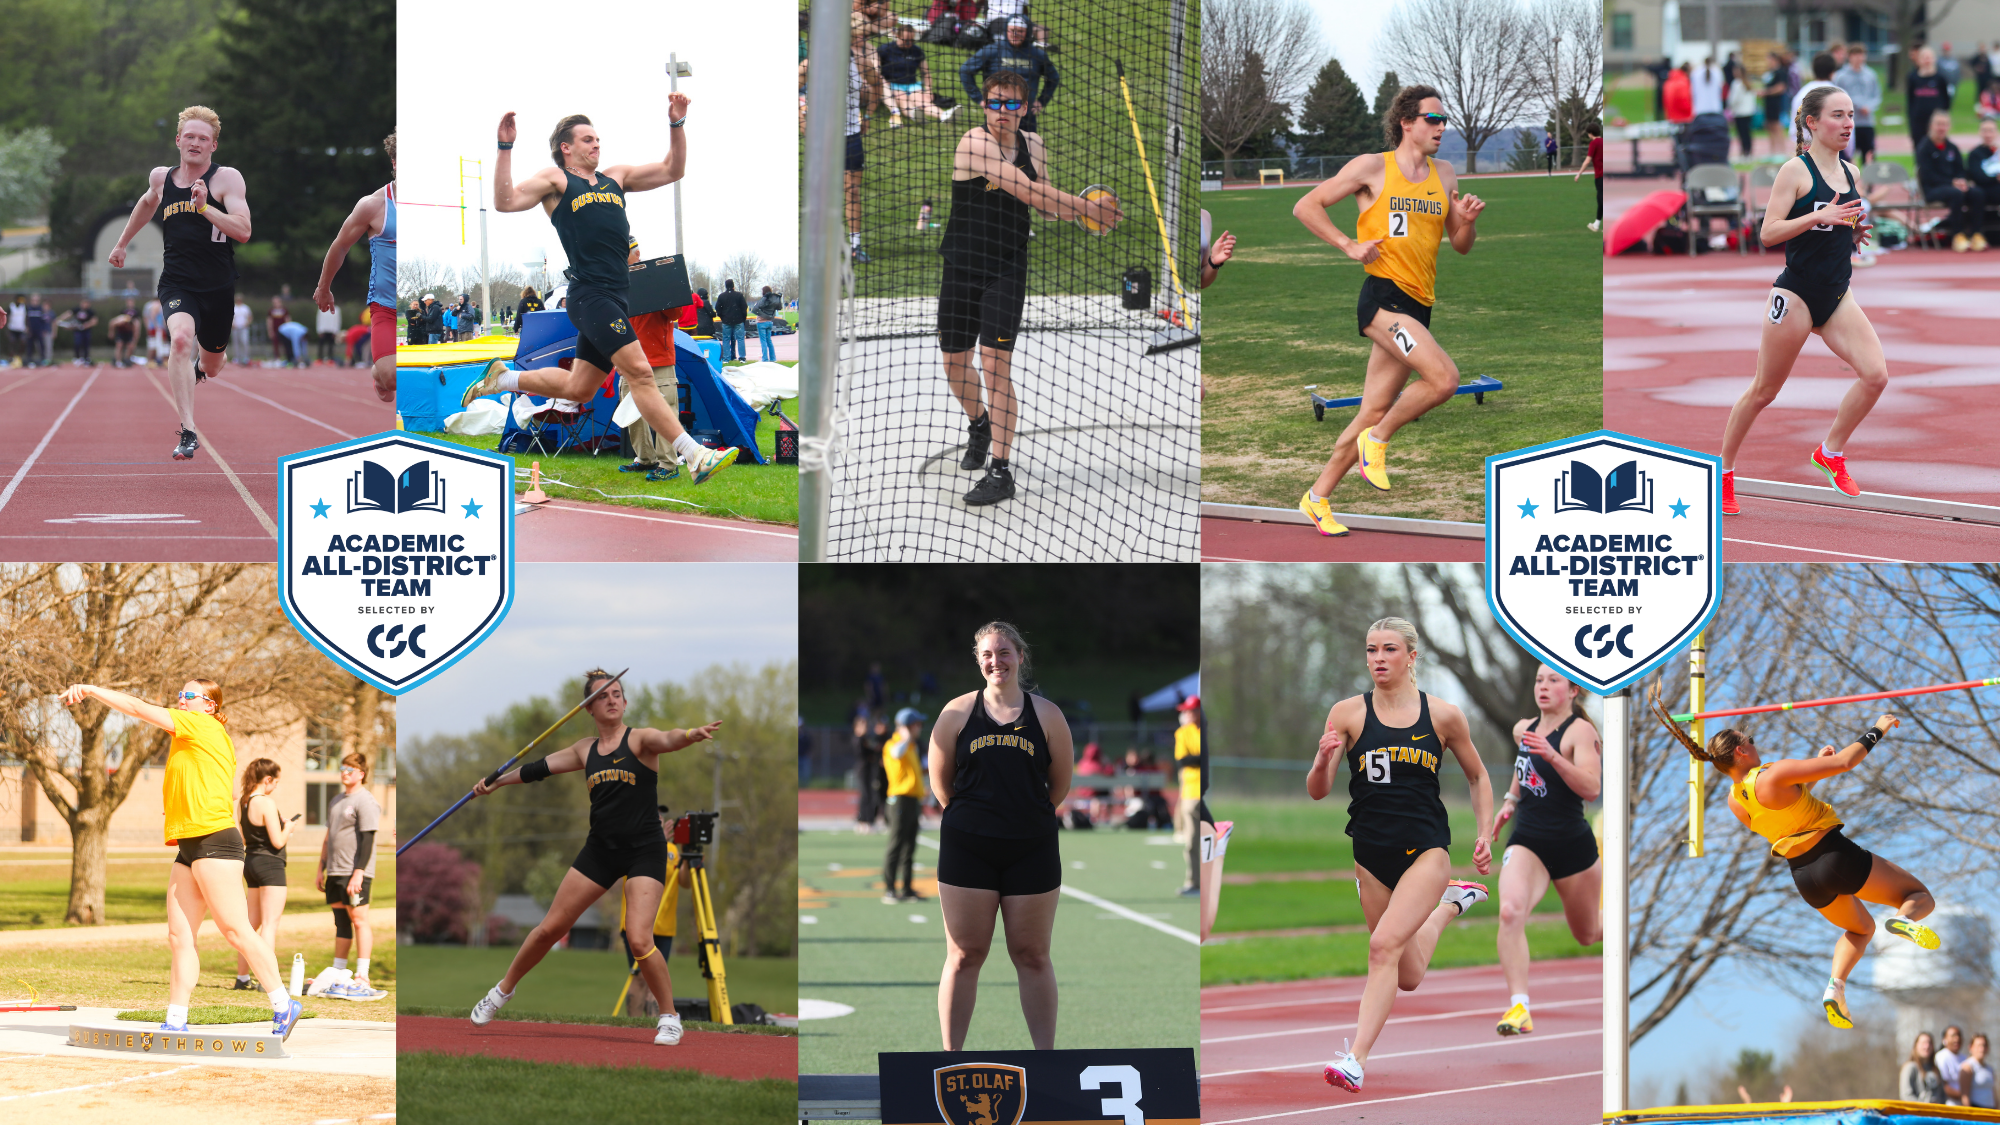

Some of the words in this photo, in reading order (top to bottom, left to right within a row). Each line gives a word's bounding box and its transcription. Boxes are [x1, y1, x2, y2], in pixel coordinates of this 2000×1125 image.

[1390, 196, 1442, 216] GUSTAVUS
[1392, 213, 1405, 237] 2
[1772, 295, 1784, 320] 9
[1395, 331, 1414, 353] 2
[970, 734, 1035, 757] GUSTAVUS
[1358, 746, 1438, 774] GTAVUS
[1371, 753, 1386, 782] 5
[1517, 759, 1524, 782] 6
[1204, 836, 1212, 861] 7
[161, 1036, 266, 1054] THROWS
[946, 1073, 970, 1092] ST.
[971, 1073, 1014, 1091] OLAF
[1079, 1064, 1145, 1125] 3
